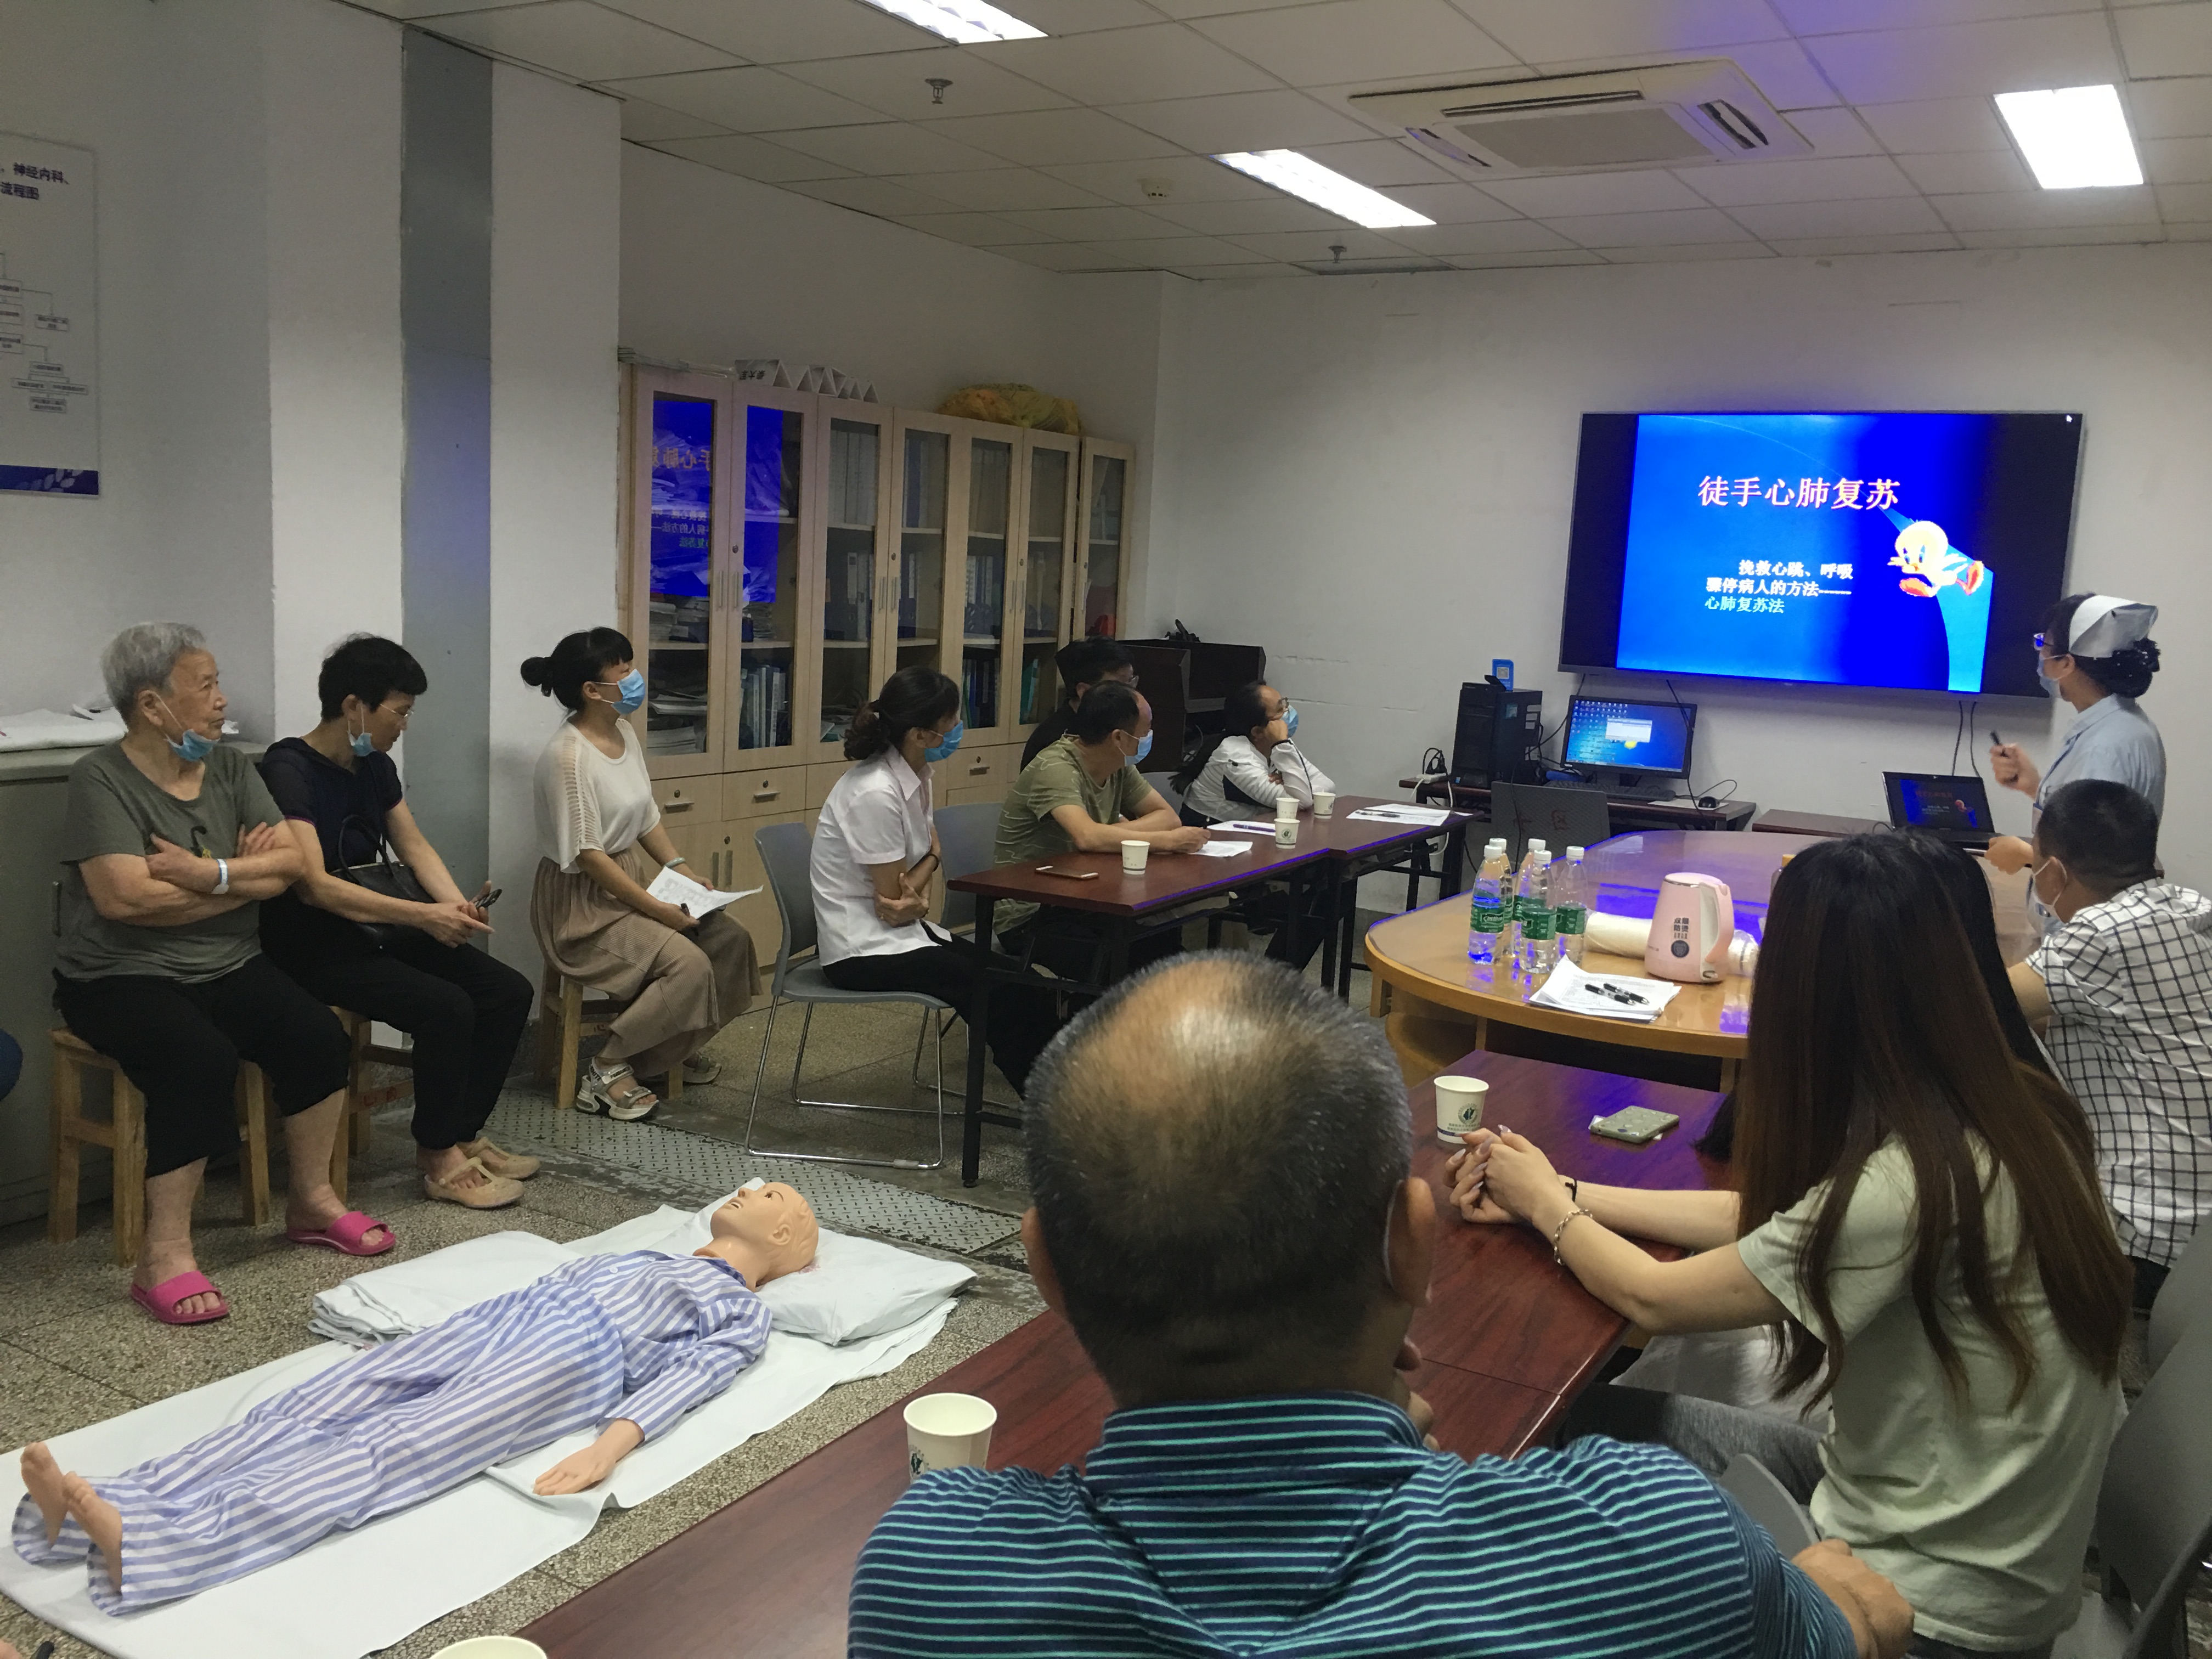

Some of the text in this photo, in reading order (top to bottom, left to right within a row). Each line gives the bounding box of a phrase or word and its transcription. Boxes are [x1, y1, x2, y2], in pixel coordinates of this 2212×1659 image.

[1698, 476, 1900, 511] 徒手心肺复苏
[1739, 560, 1854, 579] 挽救心跳、呼吸
[1705, 596, 1785, 613] 心肺复苏法
